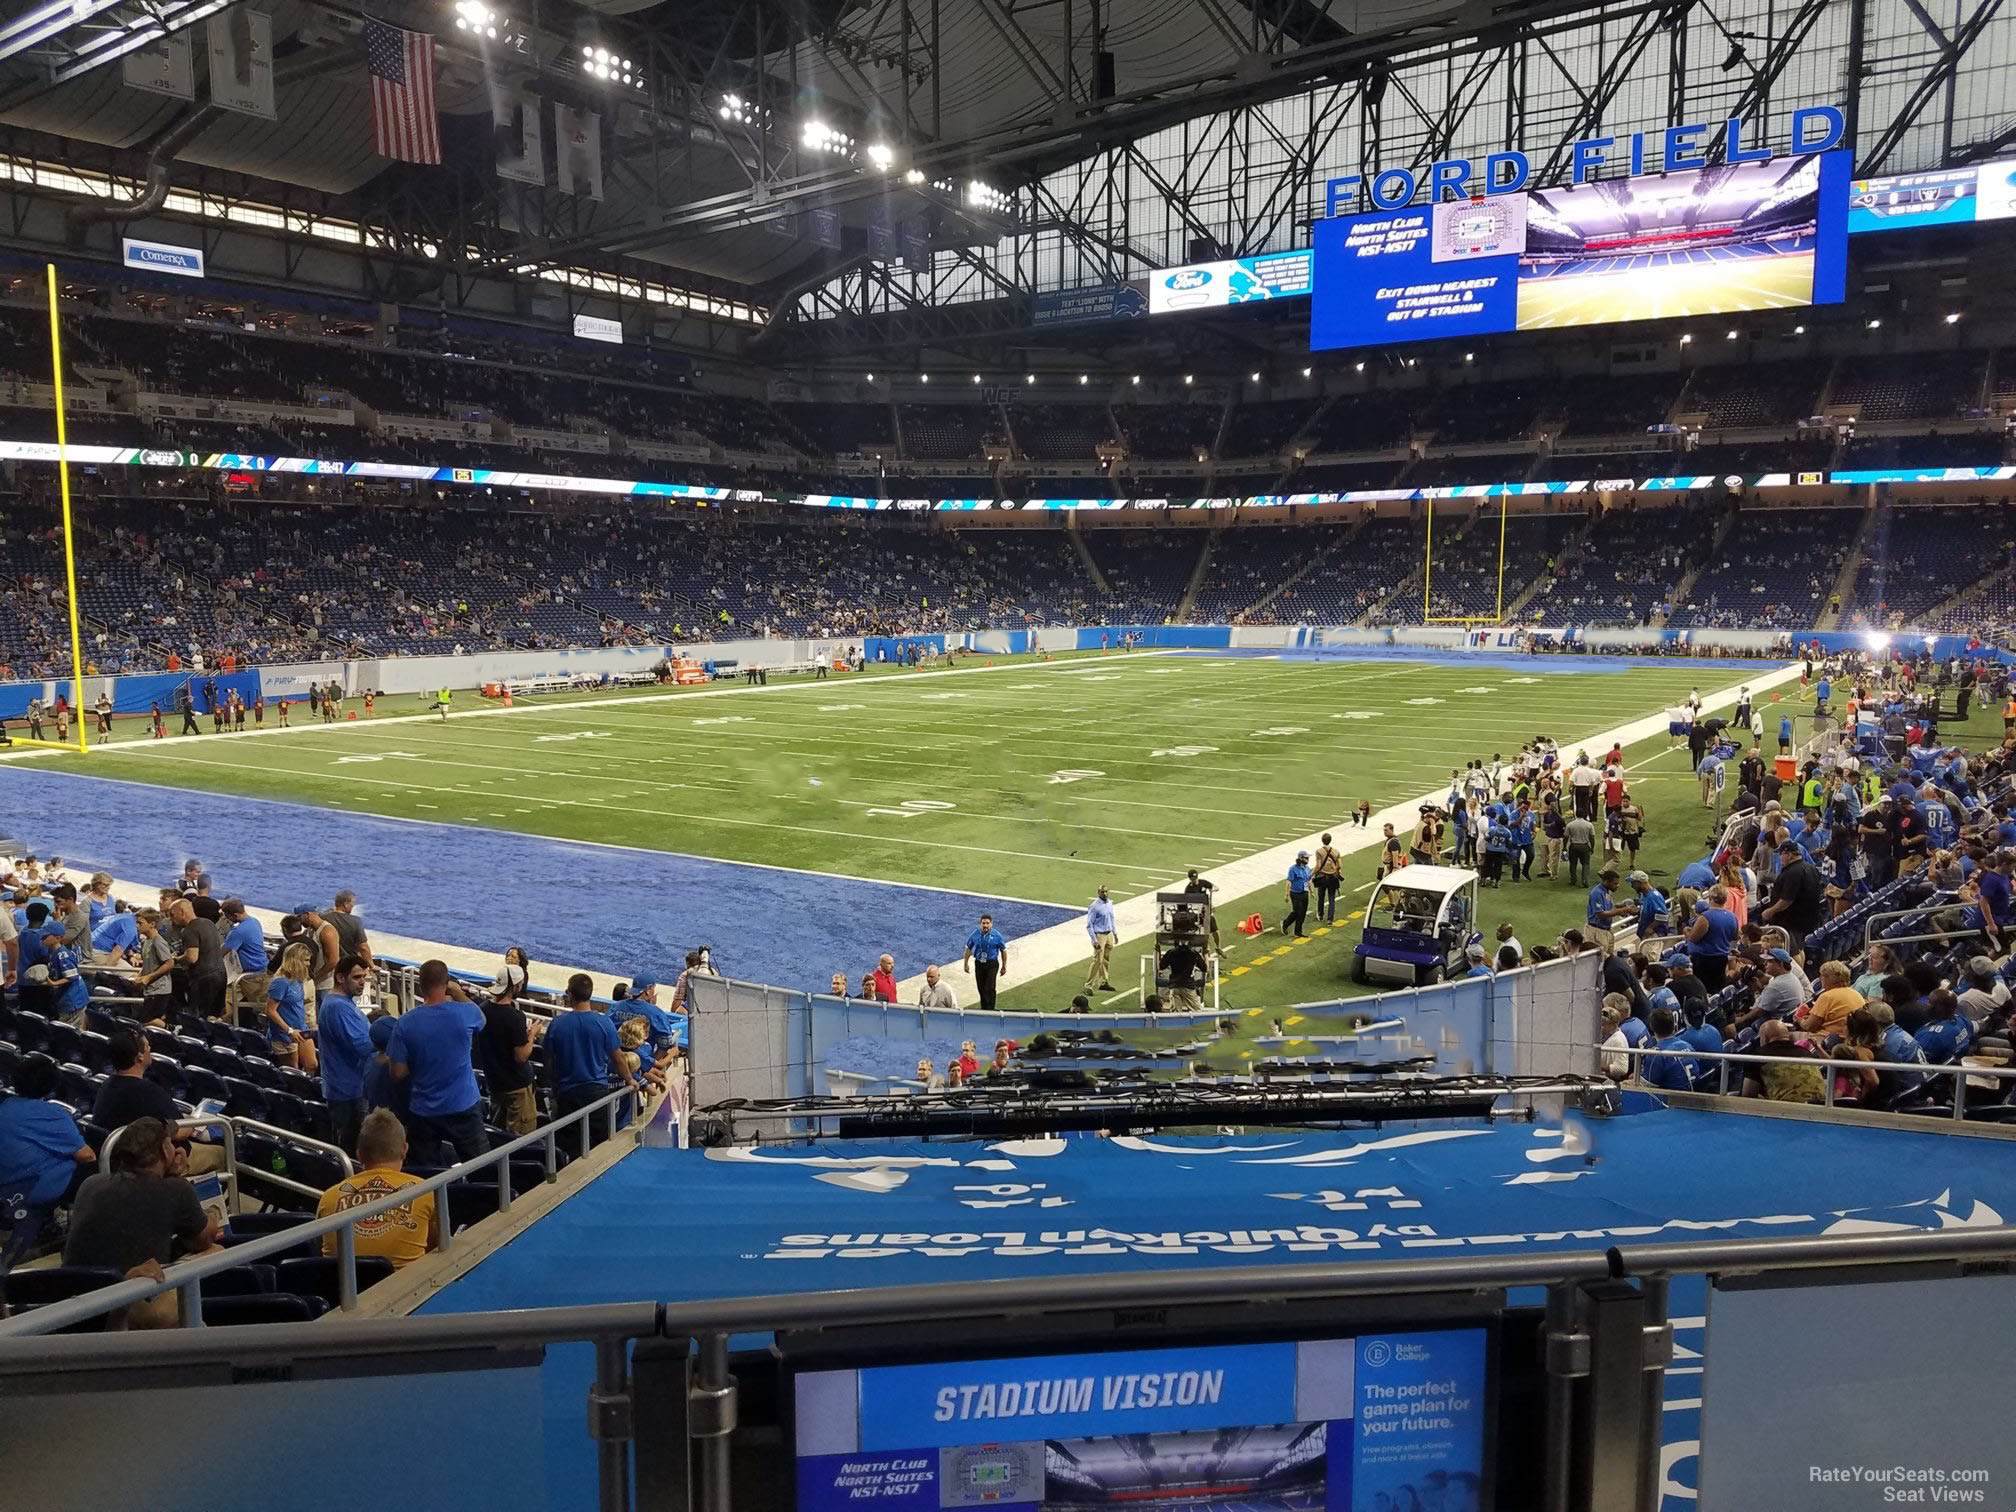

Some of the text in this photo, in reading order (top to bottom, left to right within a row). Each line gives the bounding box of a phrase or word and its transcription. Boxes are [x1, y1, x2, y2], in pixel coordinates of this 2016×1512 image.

[1324, 104, 1846, 219] FORD FIELD
[1350, 216, 1424, 235] NORTH CLUB
[1344, 227, 1429, 247] NORTH SUITES
[1375, 277, 1498, 300] EXIT DOWN NEAREST
[1395, 293, 1461, 309] STAIRWELL
[1387, 302, 1484, 322] OUT OF STADIUM
[1928, 810, 1944, 828] 87
[780, 1231, 1026, 1247] Loans
[1368, 1223, 1438, 1237] by
[1395, 1343, 1424, 1353] Baker
[1395, 1352, 1431, 1362] College
[933, 1369, 1225, 1423] STADIUM VISION
[1364, 1380, 1457, 1400] The perfect
[1363, 1397, 1470, 1419] game plan for
[1363, 1416, 1455, 1436] your future.
[840, 1459, 928, 1474] NORTH CLUB
[833, 1471, 935, 1487] NORTH SUITES
[849, 1483, 920, 1499] NS1-NS17
